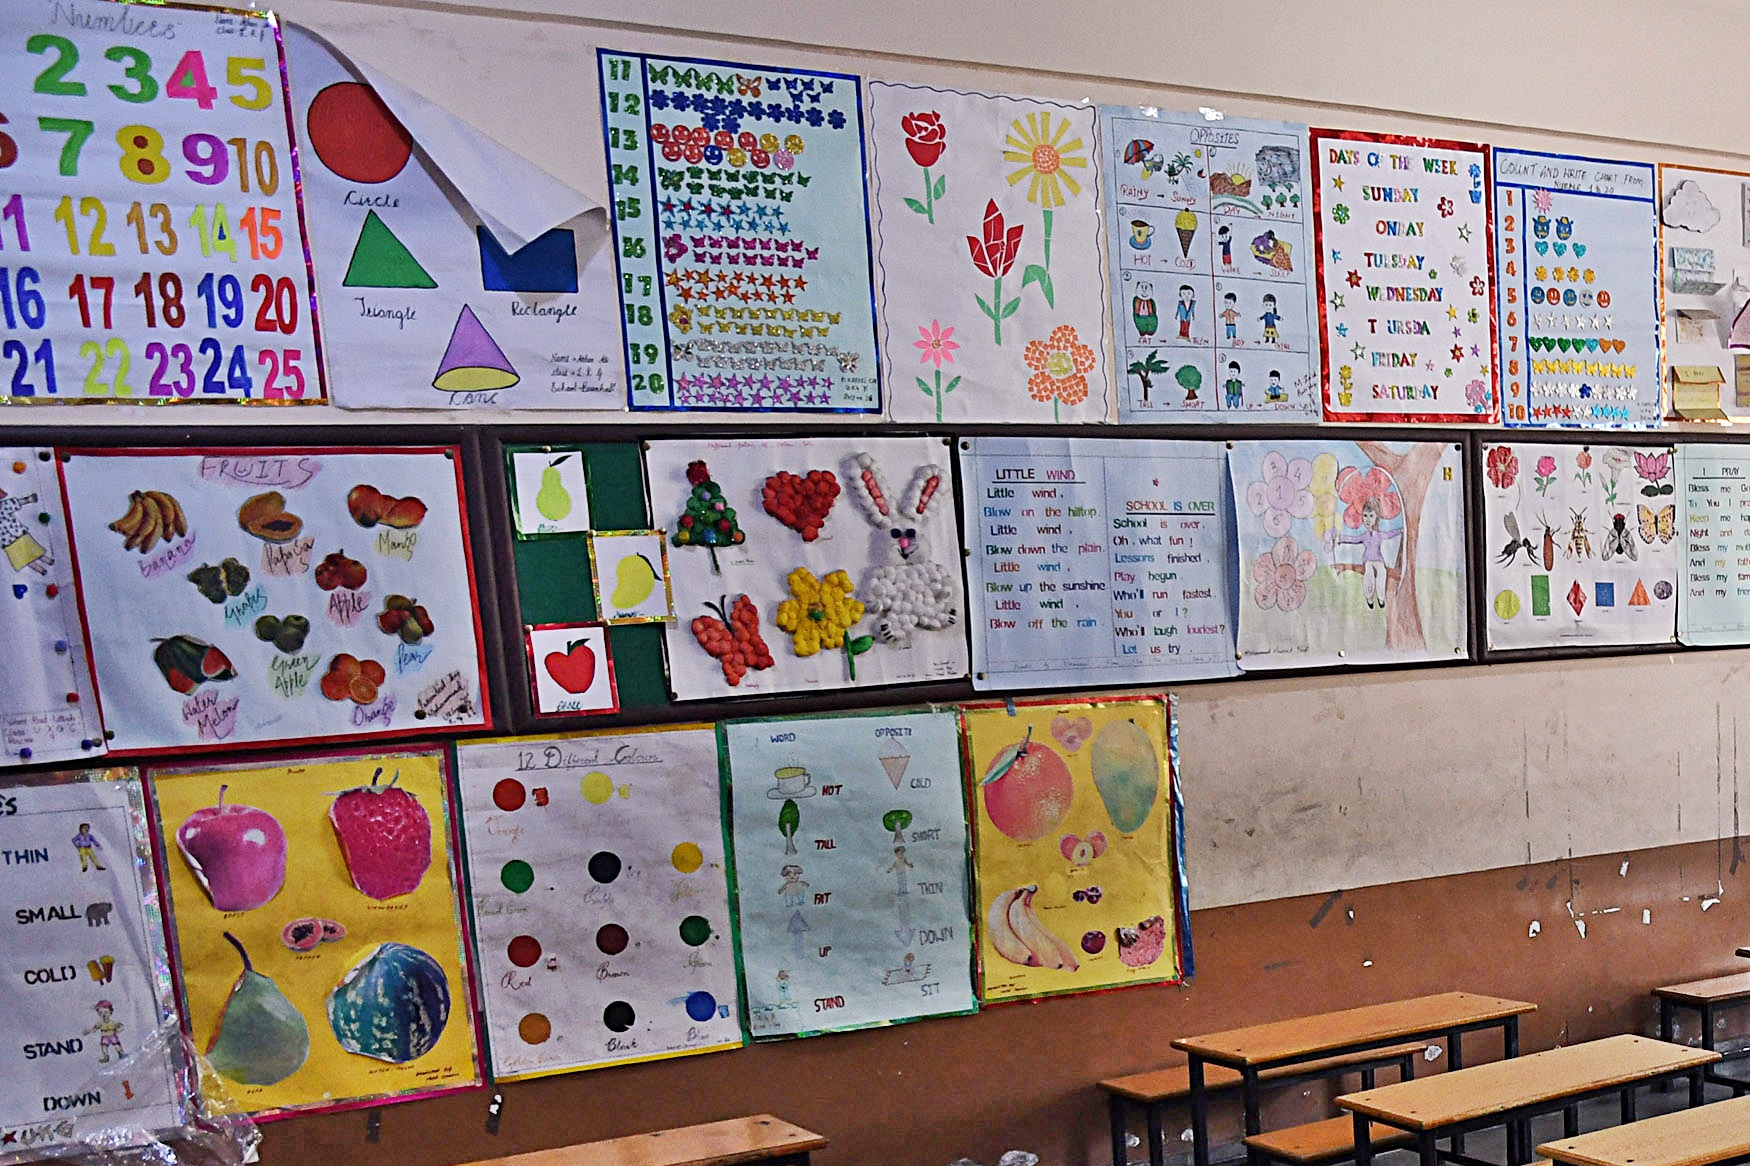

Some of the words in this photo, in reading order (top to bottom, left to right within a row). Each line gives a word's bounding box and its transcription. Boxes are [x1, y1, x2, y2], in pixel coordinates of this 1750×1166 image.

[26, 34, 87, 96] 2
[104, 46, 159, 103] 3
[166, 50, 217, 110] 4
[226, 57, 273, 111] 5
[609, 59, 631, 81] 11
[608, 92, 640, 115] 12
[609, 127, 639, 150] 13
[38, 116, 94, 176] 7
[116, 125, 171, 184] 8
[182, 133, 229, 185] 9
[227, 137, 279, 196] 10
[1329, 149, 1360, 166] DAYS
[1390, 154, 1412, 170] TH
[1423, 158, 1458, 175] WEEK
[612, 164, 639, 186] 14
[1500, 158, 1538, 175] COUNT
[1540, 165, 1559, 178] AND
[1563, 168, 1587, 180] WRITE
[344, 190, 400, 208] Circle
[1363, 186, 1419, 203] SUNDAY
[1506, 190, 1513, 206] 1
[616, 197, 641, 221] 15
[55, 196, 116, 256] 12
[127, 201, 178, 255] 13
[189, 203, 237, 263] 14
[240, 206, 284, 260] 15
[1505, 215, 1515, 232] 2
[622, 237, 646, 259] 16
[1505, 238, 1516, 254] 3
[1134, 254, 1152, 265] HOT
[1364, 252, 1425, 270] TUESDAY
[1506, 260, 1517, 277] 4
[624, 273, 652, 296] 17
[1366, 285, 1444, 302] WEDNESDAY
[0, 266, 46, 330] 16
[69, 274, 115, 329] 17
[135, 272, 186, 328] 18
[197, 272, 244, 329] 19
[251, 274, 298, 335] 20
[1507, 287, 1517, 303] 5
[354, 297, 416, 329] Triangle
[511, 302, 578, 323] Rectangle
[625, 303, 653, 326] 18
[1507, 311, 1517, 327] 6
[630, 343, 658, 364] 19
[1509, 336, 1518, 352] 7
[3, 338, 57, 396] 21
[80, 338, 133, 396] 22
[145, 342, 196, 399] 23
[199, 337, 253, 398] 24
[258, 349, 305, 400] 25
[1371, 352, 1417, 368] FRIDAY
[1509, 359, 1519, 376] 8
[632, 374, 665, 394] 20
[1372, 384, 1439, 400] SATURDAY
[1510, 381, 1520, 398] 9
[1508, 403, 1525, 420] 10
[202, 456, 314, 489] FRUITS
[996, 468, 1036, 480] LITTLE
[1046, 469, 1076, 480] WIND
[1722, 467, 1740, 476] PRAY
[984, 507, 1011, 517] Blow
[1022, 509, 1034, 517] on
[1045, 507, 1061, 517] the
[1126, 501, 1167, 511] SCHOOL
[1174, 501, 1182, 511] IS
[1188, 501, 1215, 511] OVER
[1113, 518, 1147, 529] School
[986, 582, 1012, 592] Blow
[1020, 583, 1032, 593] up
[1040, 582, 1056, 592] the
[1063, 581, 1105, 591] sunshine
[1113, 588, 1144, 600] Who'll
[1153, 591, 1168, 599] run
[1123, 645, 1137, 654] Let
[1150, 646, 1161, 654] us
[770, 733, 796, 743] WORD
[875, 728, 912, 739] OPPOSITE
[518, 751, 536, 770] 12
[822, 785, 843, 796] HOT
[910, 778, 931, 789] COLD
[814, 839, 837, 850] TALL
[912, 828, 941, 843] SHORT
[2, 847, 49, 865] THIN
[814, 893, 832, 905] FAT
[917, 881, 943, 895] THIN
[16, 904, 82, 924] SMALL
[819, 946, 832, 957] UP
[919, 927, 954, 945] DOWN
[24, 965, 76, 985] COLD
[814, 996, 845, 1012] STAND
[921, 983, 940, 996] SIT
[23, 1038, 84, 1059] STAND
[43, 1091, 101, 1112] DOWN
